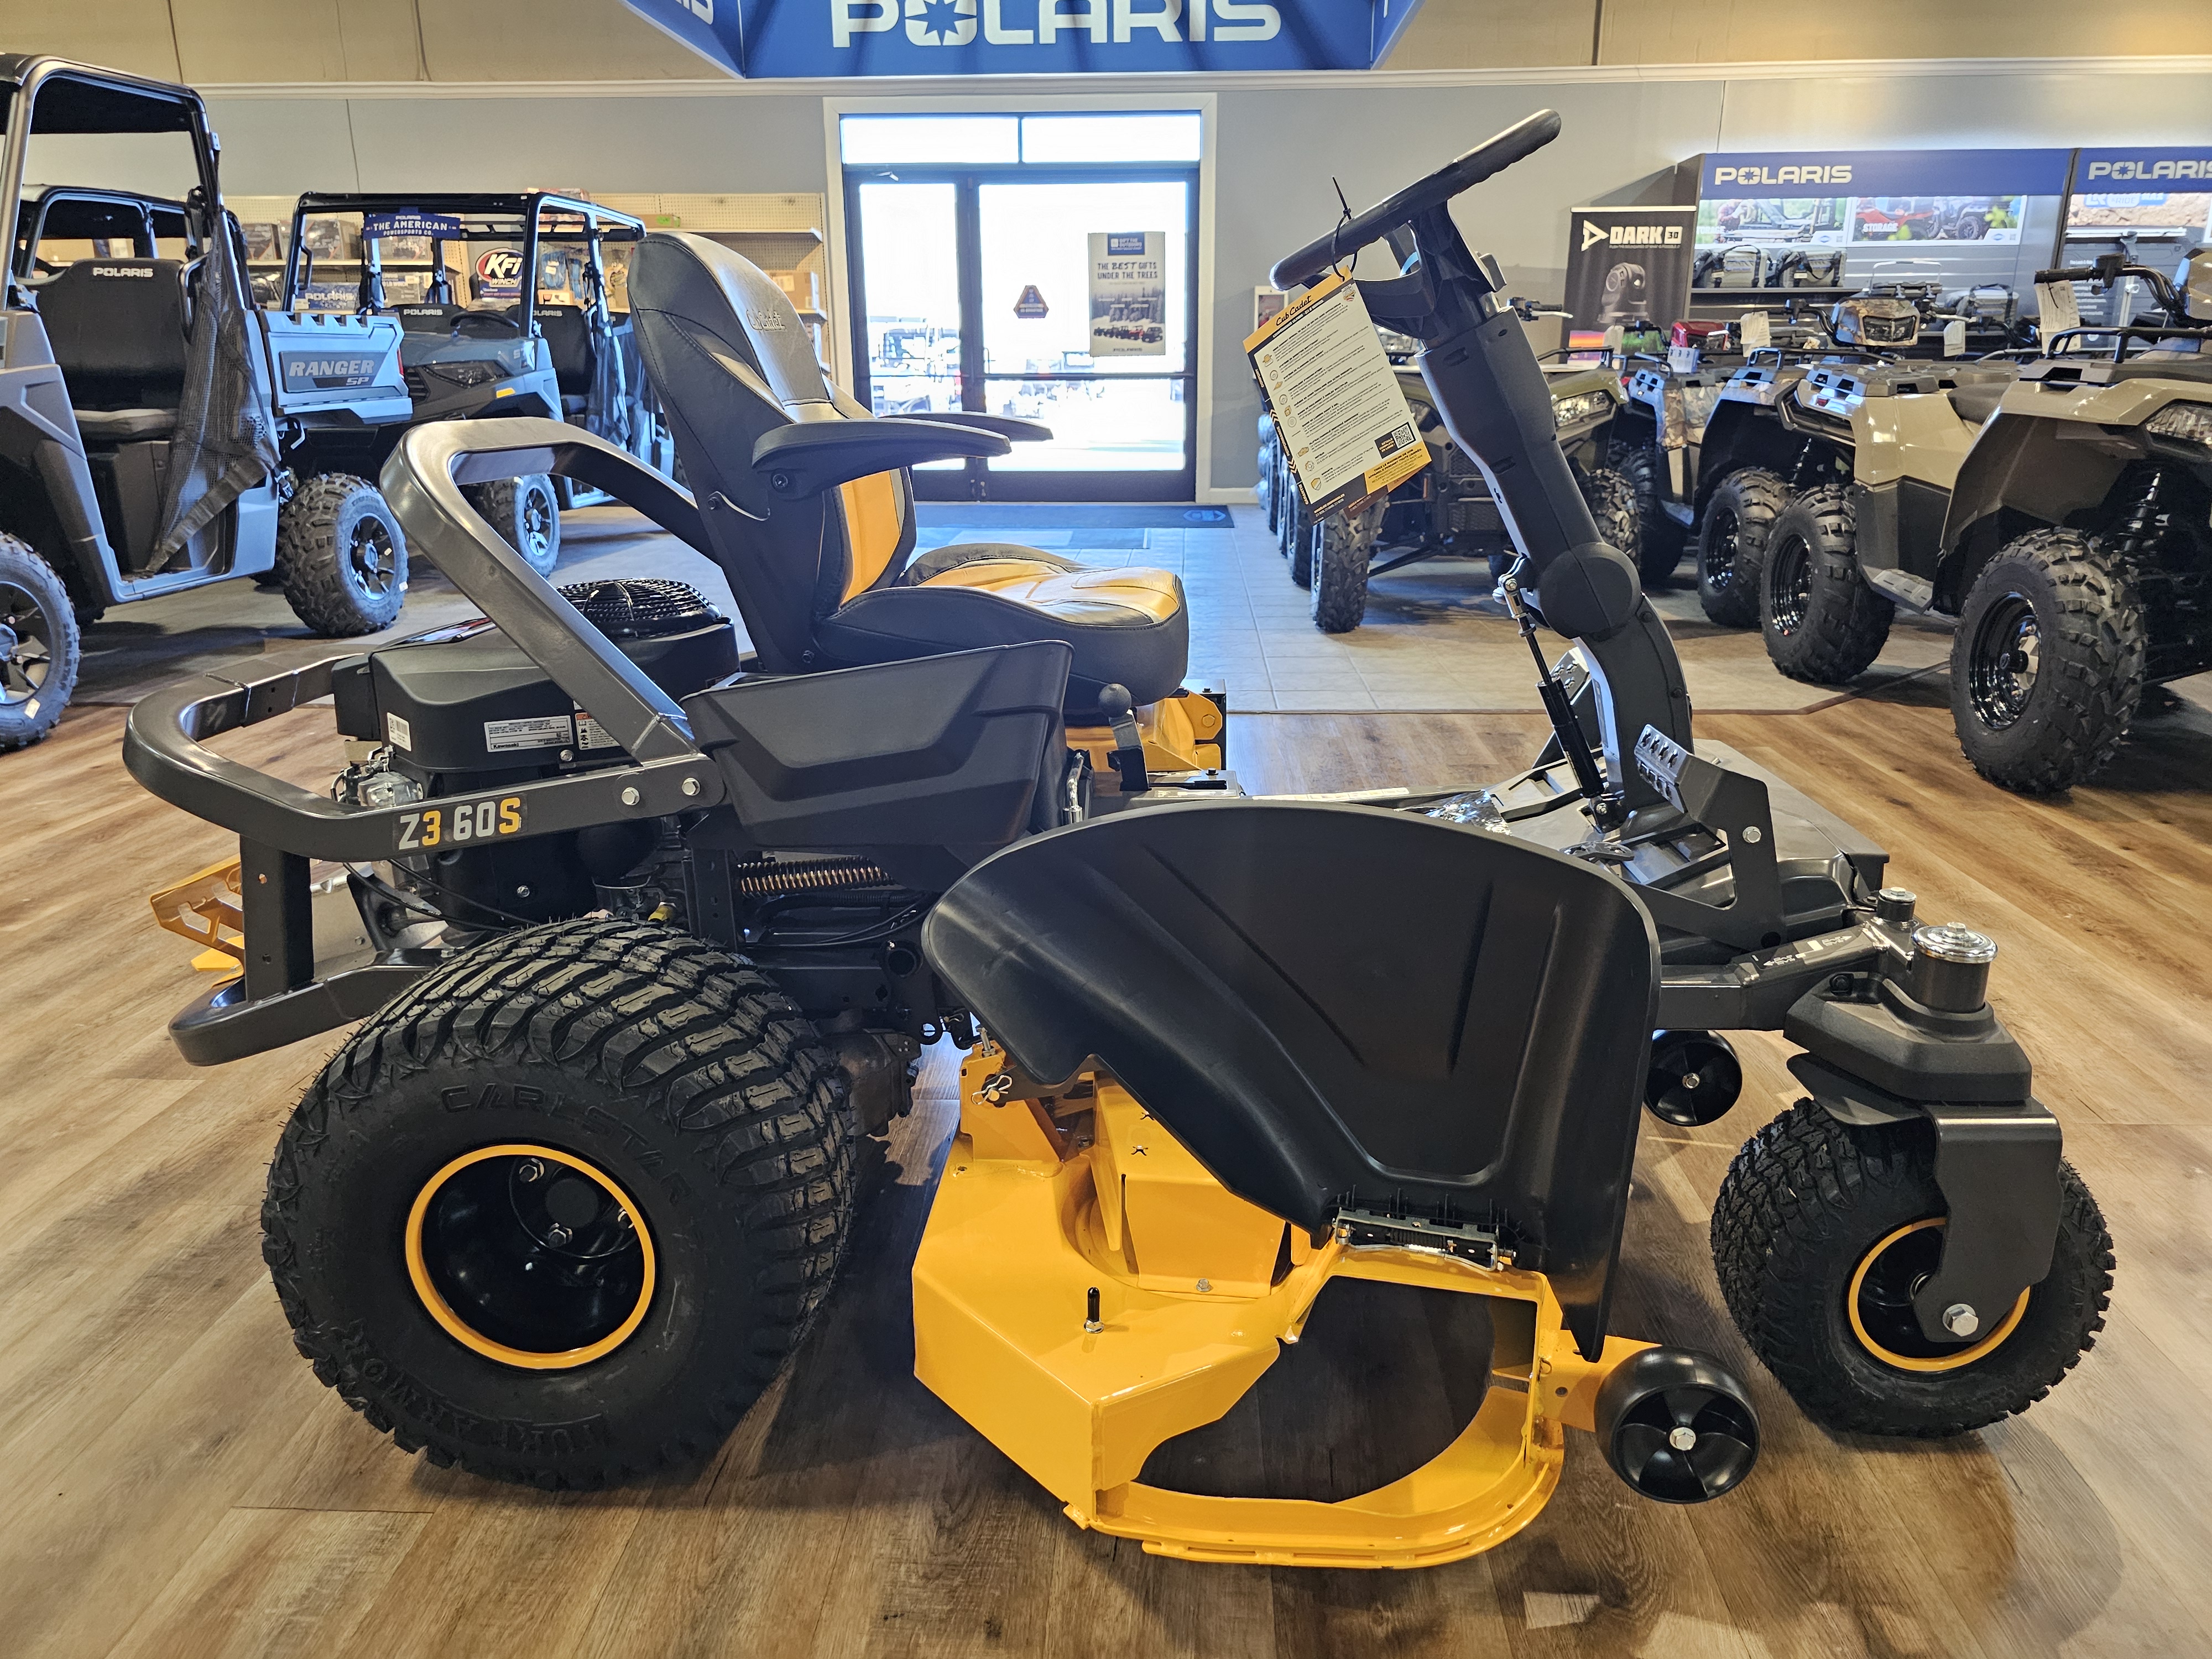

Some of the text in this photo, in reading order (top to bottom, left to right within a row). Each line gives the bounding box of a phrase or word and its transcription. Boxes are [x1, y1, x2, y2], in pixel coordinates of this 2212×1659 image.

[833, 0, 1282, 48] POLARIS
[1715, 165, 1852, 185] POLARIS
[373, 221, 448, 231] THE AMERICAN
[1697, 226, 1726, 234] TORAGE
[1863, 222, 1898, 232] STORAGE
[1610, 226, 1663, 244] DARK
[93, 267, 153, 278] POLARIS
[1276, 312, 1289, 326] Cub
[1290, 295, 1312, 315] Cadet
[289, 360, 374, 377] RANGER
[346, 377, 369, 385] SP
[399, 797, 520, 849] Z3 60S
[442, 1084, 692, 1207] CARLSTAR
